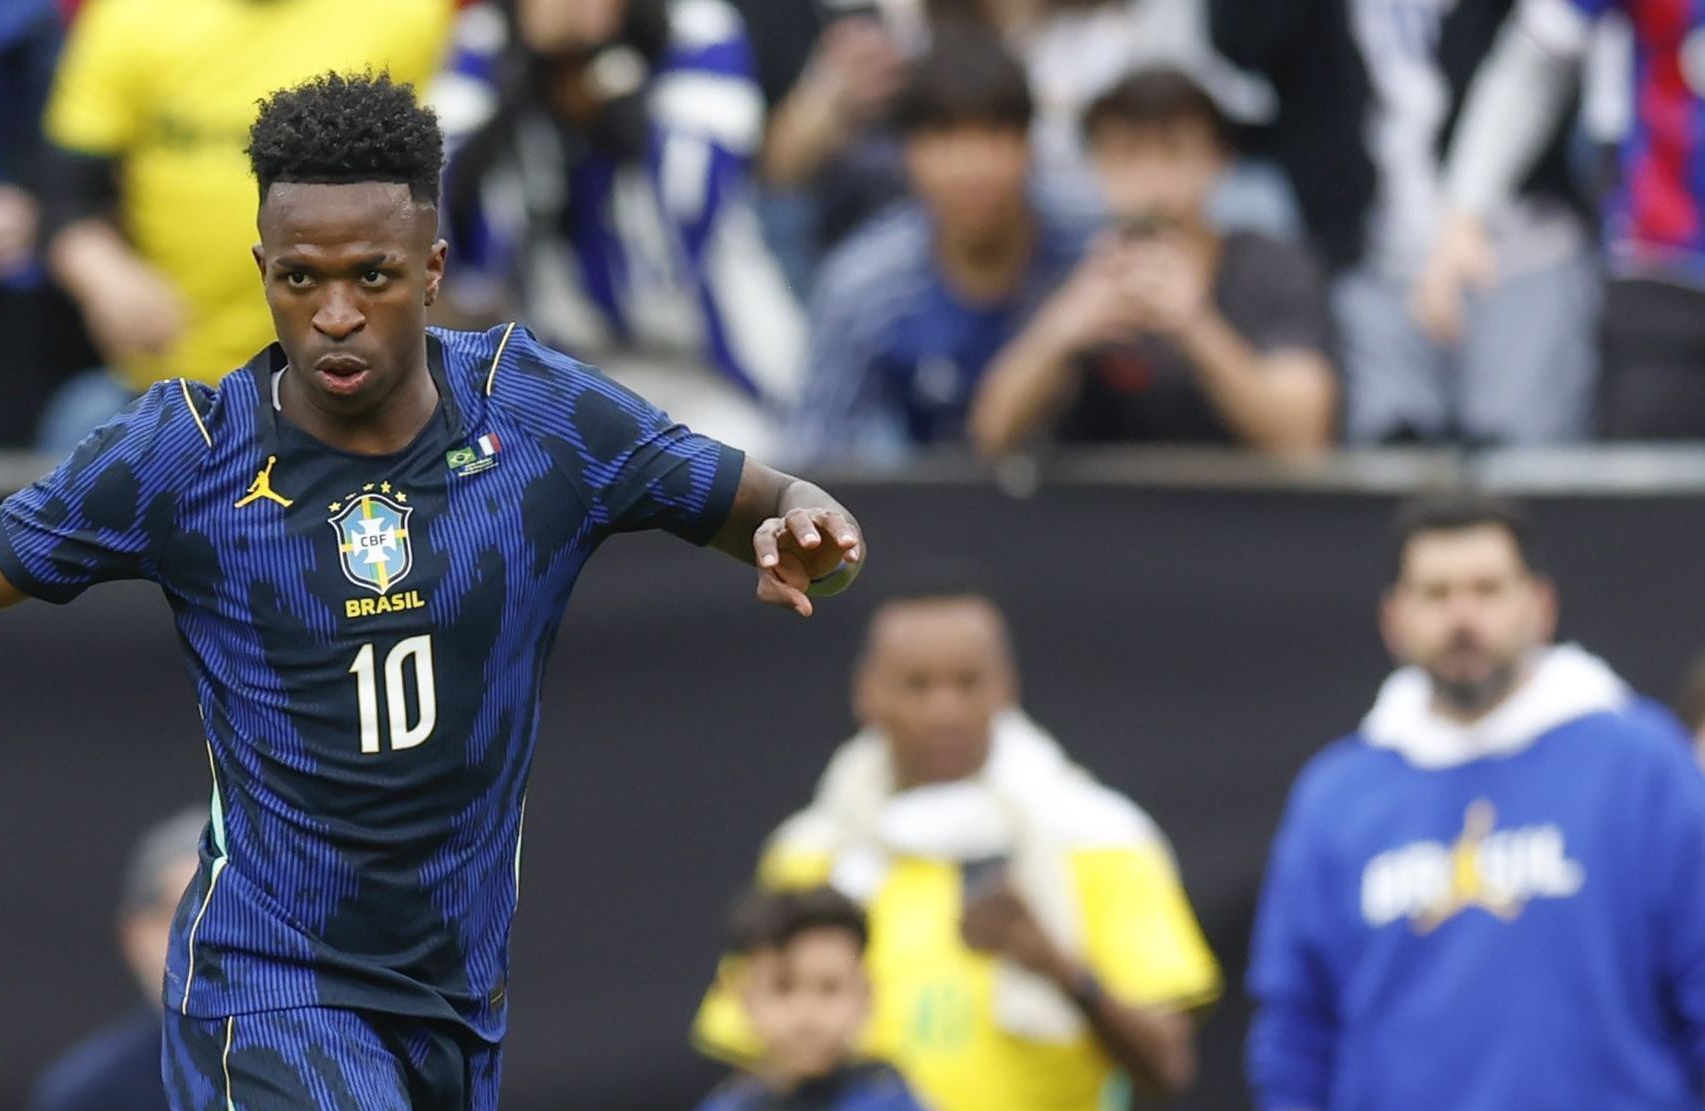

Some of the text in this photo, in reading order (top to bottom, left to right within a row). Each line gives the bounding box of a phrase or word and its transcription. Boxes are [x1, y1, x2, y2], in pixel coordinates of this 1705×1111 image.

[360, 534, 387, 547] CBF
[345, 591, 424, 617] BRASIL
[349, 634, 437, 753] 10
